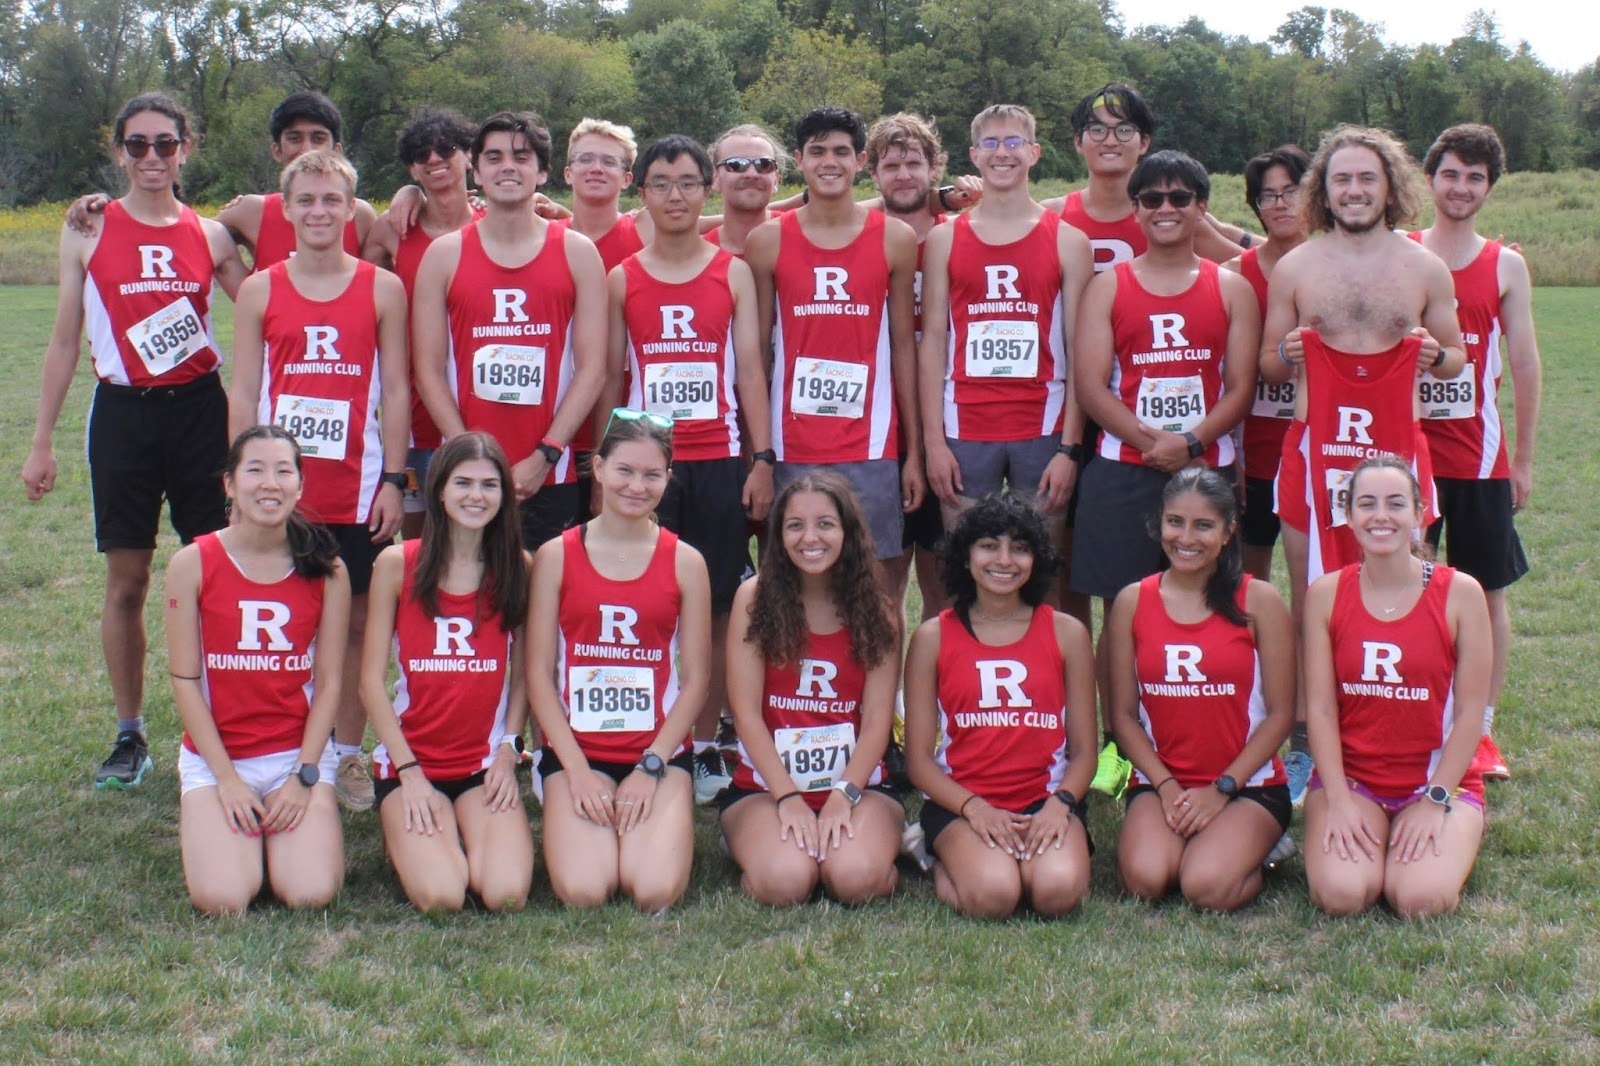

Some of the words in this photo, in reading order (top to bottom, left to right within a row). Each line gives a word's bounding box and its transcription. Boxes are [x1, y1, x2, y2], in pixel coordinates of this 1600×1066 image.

[138, 245, 177, 278] R
[119, 281, 169, 295] RUNNING
[171, 281, 201, 293] CLUB
[813, 266, 851, 301] R
[984, 264, 1021, 300] R
[492, 288, 529, 323] R
[793, 303, 841, 317] RUNNING
[842, 303, 870, 316] CLUB
[967, 301, 1013, 315] RUNNING
[1015, 301, 1039, 315] CLUB
[472, 324, 521, 339] RUNNING
[523, 323, 551, 336] CLUB
[659, 305, 697, 339] R
[1149, 312, 1189, 349] R
[139, 314, 199, 360] 19359
[303, 325, 341, 360] R
[691, 341, 718, 354] CLUB
[1461, 332, 1479, 344] LUB
[969, 338, 1035, 361] 19357
[1132, 350, 1183, 366] RUNNING
[1184, 348, 1212, 362] CLUB
[334, 363, 362, 376] CLUB
[477, 363, 541, 387] 19364
[648, 380, 714, 404] 19350
[797, 376, 863, 403] 19347
[1257, 382, 1296, 403] 193
[1419, 382, 1472, 404] 9353
[1140, 393, 1202, 418] 19354
[278, 414, 344, 442] 19348
[1336, 406, 1373, 444] R
[1322, 446, 1364, 458] UNNING
[237, 600, 293, 651] R
[433, 616, 476, 657] R
[598, 604, 640, 645] R
[207, 654, 281, 671] RUNNING
[574, 643, 631, 661] RUNNING
[632, 648, 662, 661] CLUB
[1163, 644, 1207, 683] R
[1361, 641, 1403, 684] R
[409, 659, 466, 672] RUNNING
[468, 660, 497, 672] CLUB
[795, 658, 838, 699] R
[975, 659, 1033, 708] R
[1143, 682, 1201, 697] RUNNING
[1202, 683, 1236, 697] CLUB
[574, 687, 650, 712] 19365
[769, 695, 828, 713] RUNNING
[1394, 685, 1430, 701] CLUB
[1023, 713, 1058, 730] CLUB
[780, 744, 851, 774] 19371
